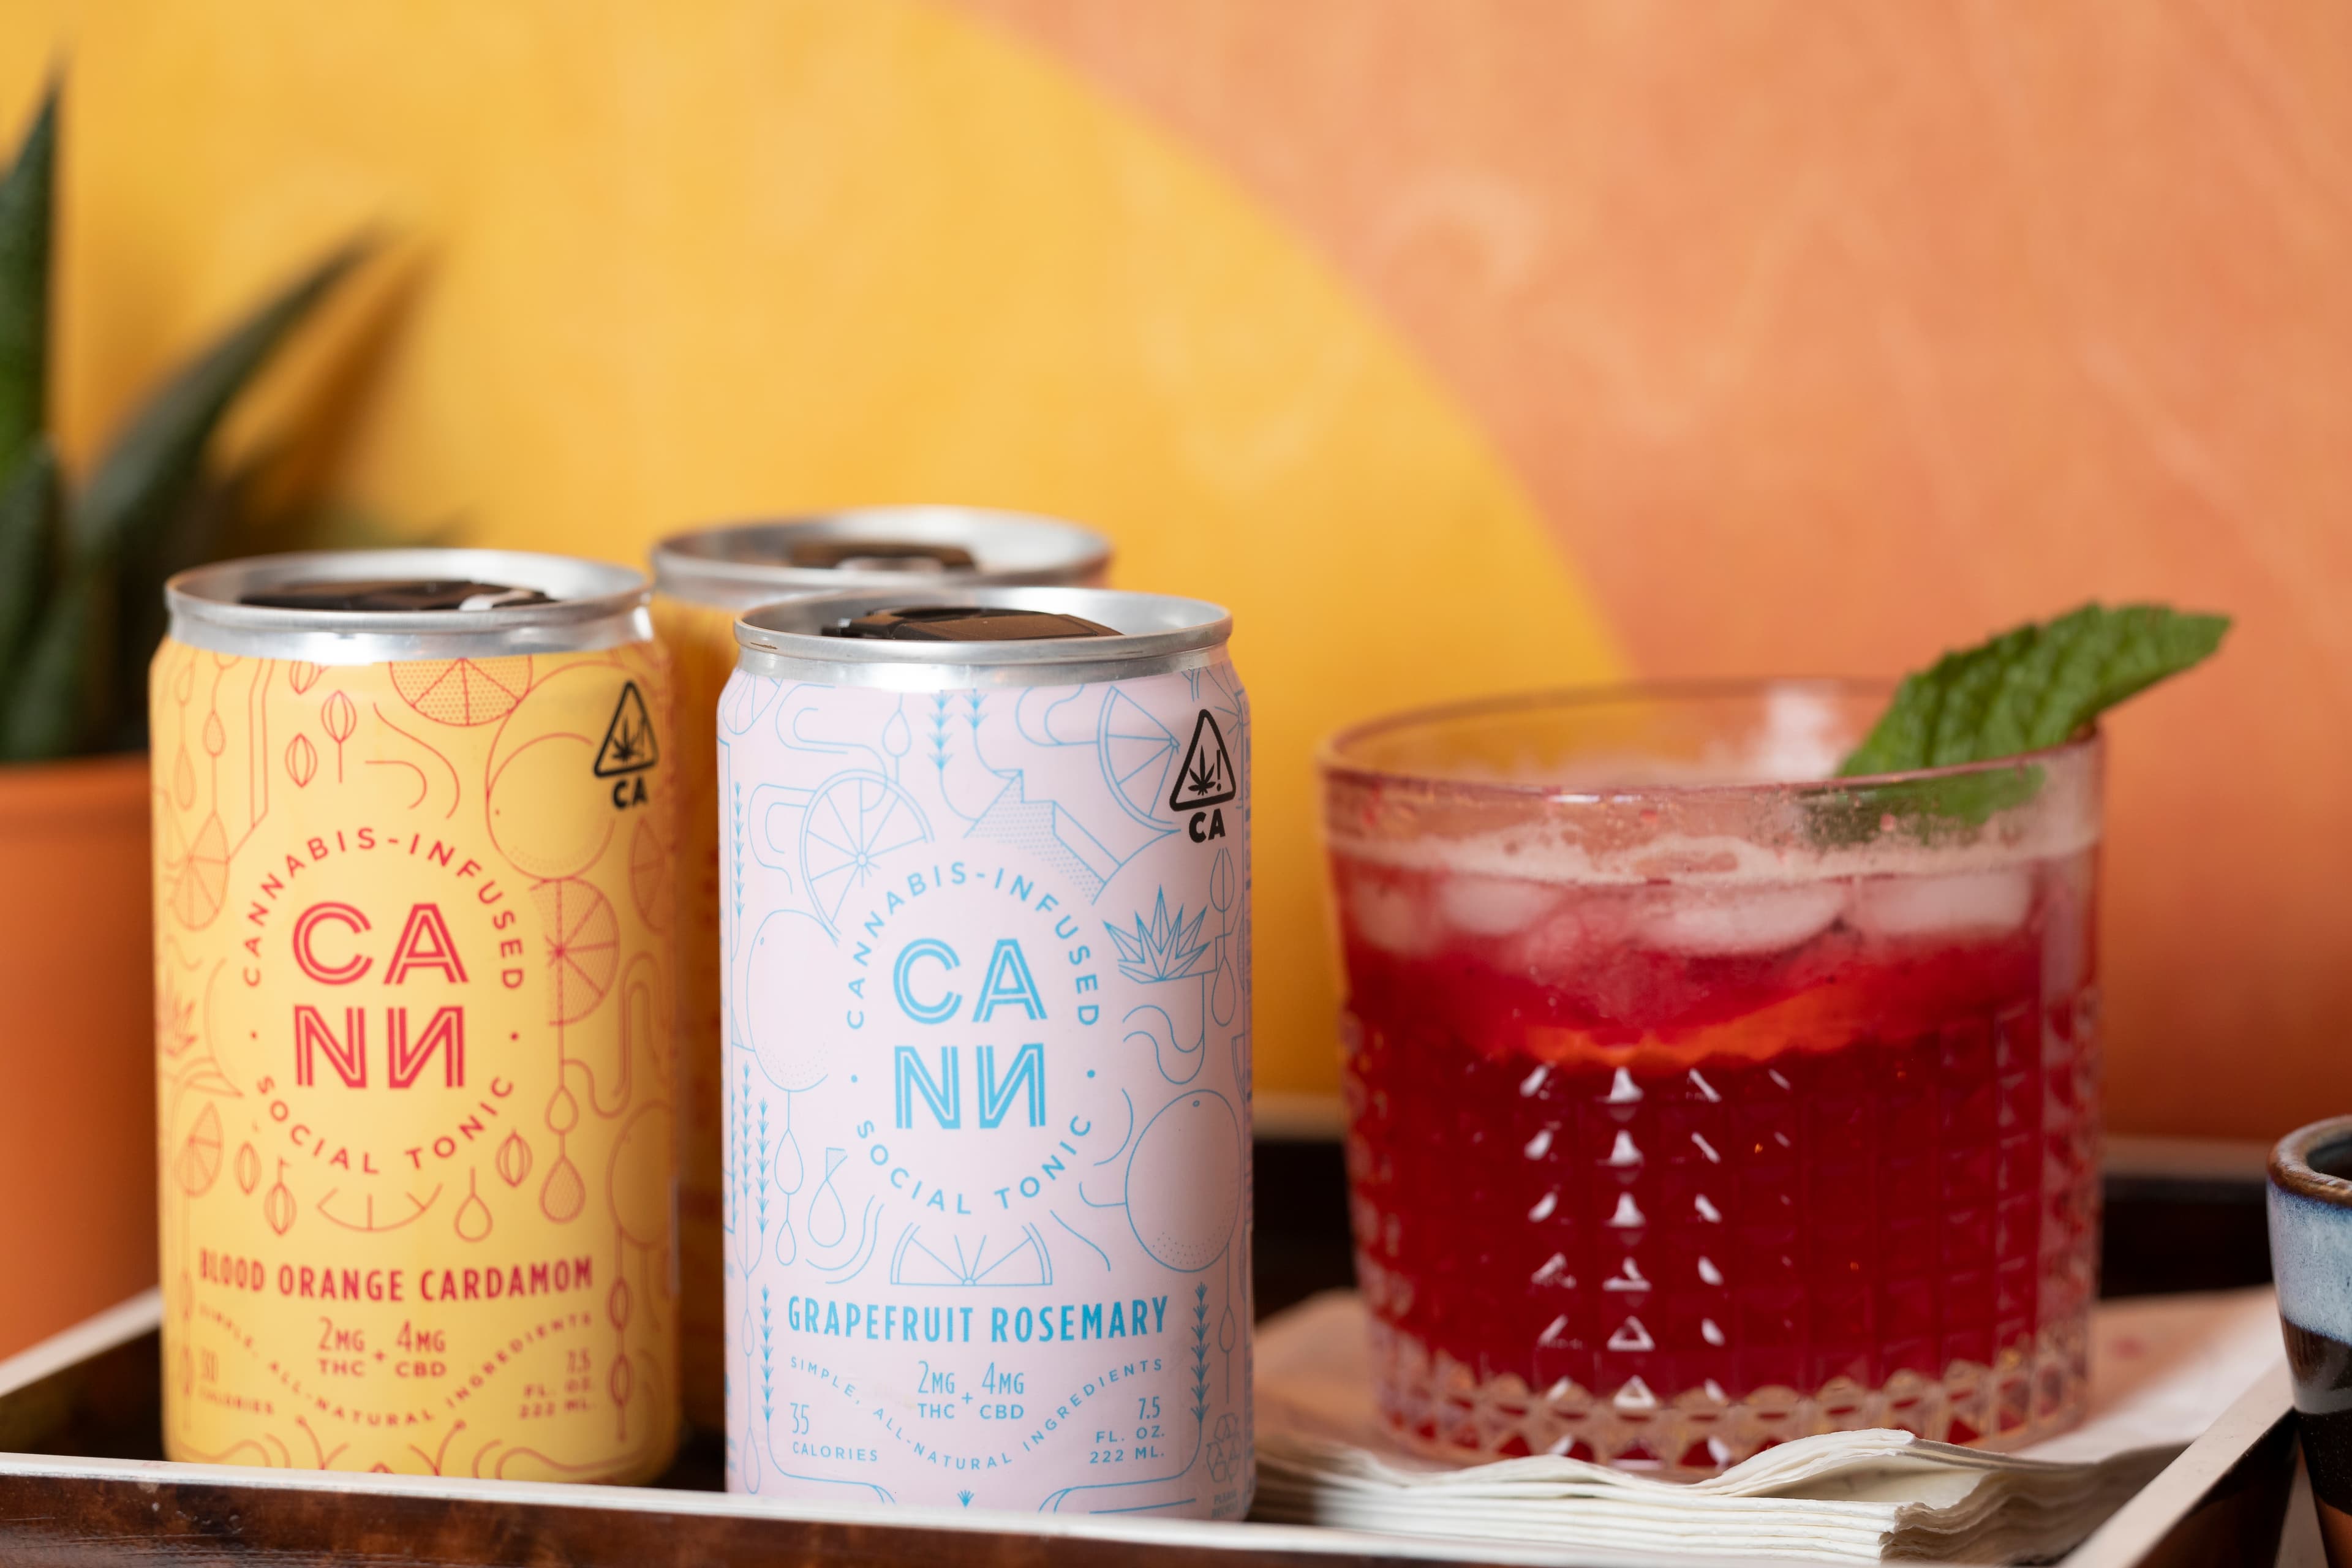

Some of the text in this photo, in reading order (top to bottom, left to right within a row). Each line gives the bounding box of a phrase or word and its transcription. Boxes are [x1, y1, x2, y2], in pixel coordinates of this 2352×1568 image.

[613, 776, 649, 810] CA
[1189, 809, 1225, 843] CA
[243, 827, 524, 989] CANNABIS-INFUSED
[292, 901, 470, 986] CA
[846, 861, 1099, 1030] CANNABIS-INFUSED
[892, 938, 1048, 1025] CA
[257, 1076, 514, 1174] SOCIAL TONIC
[857, 1115, 1091, 1215] SOCIAL TONIC
[200, 1248, 592, 1302] BLOOD ORANGE CARDAMOM
[318, 1316, 365, 1352] 2MG
[396, 1319, 447, 1352] 4MG
[788, 1295, 1168, 1343] GRAPEFRUIT ROSEMARY
[318, 1358, 447, 1378] THC CBD
[918, 1360, 956, 1394] 2MG
[982, 1362, 1024, 1395] 4MG
[790, 1403, 809, 1435] 35
[791, 1356, 1162, 1470] SIMPLE, ALL-NATURAL INGREDIENTS
[918, 1403, 1024, 1420] THC CBD
[1139, 1396, 1161, 1420] 7.5
[793, 1441, 878, 1461] CALORIES
[1096, 1425, 1165, 1443] FL. OZ.
[1090, 1446, 1164, 1464] 222 ML.
